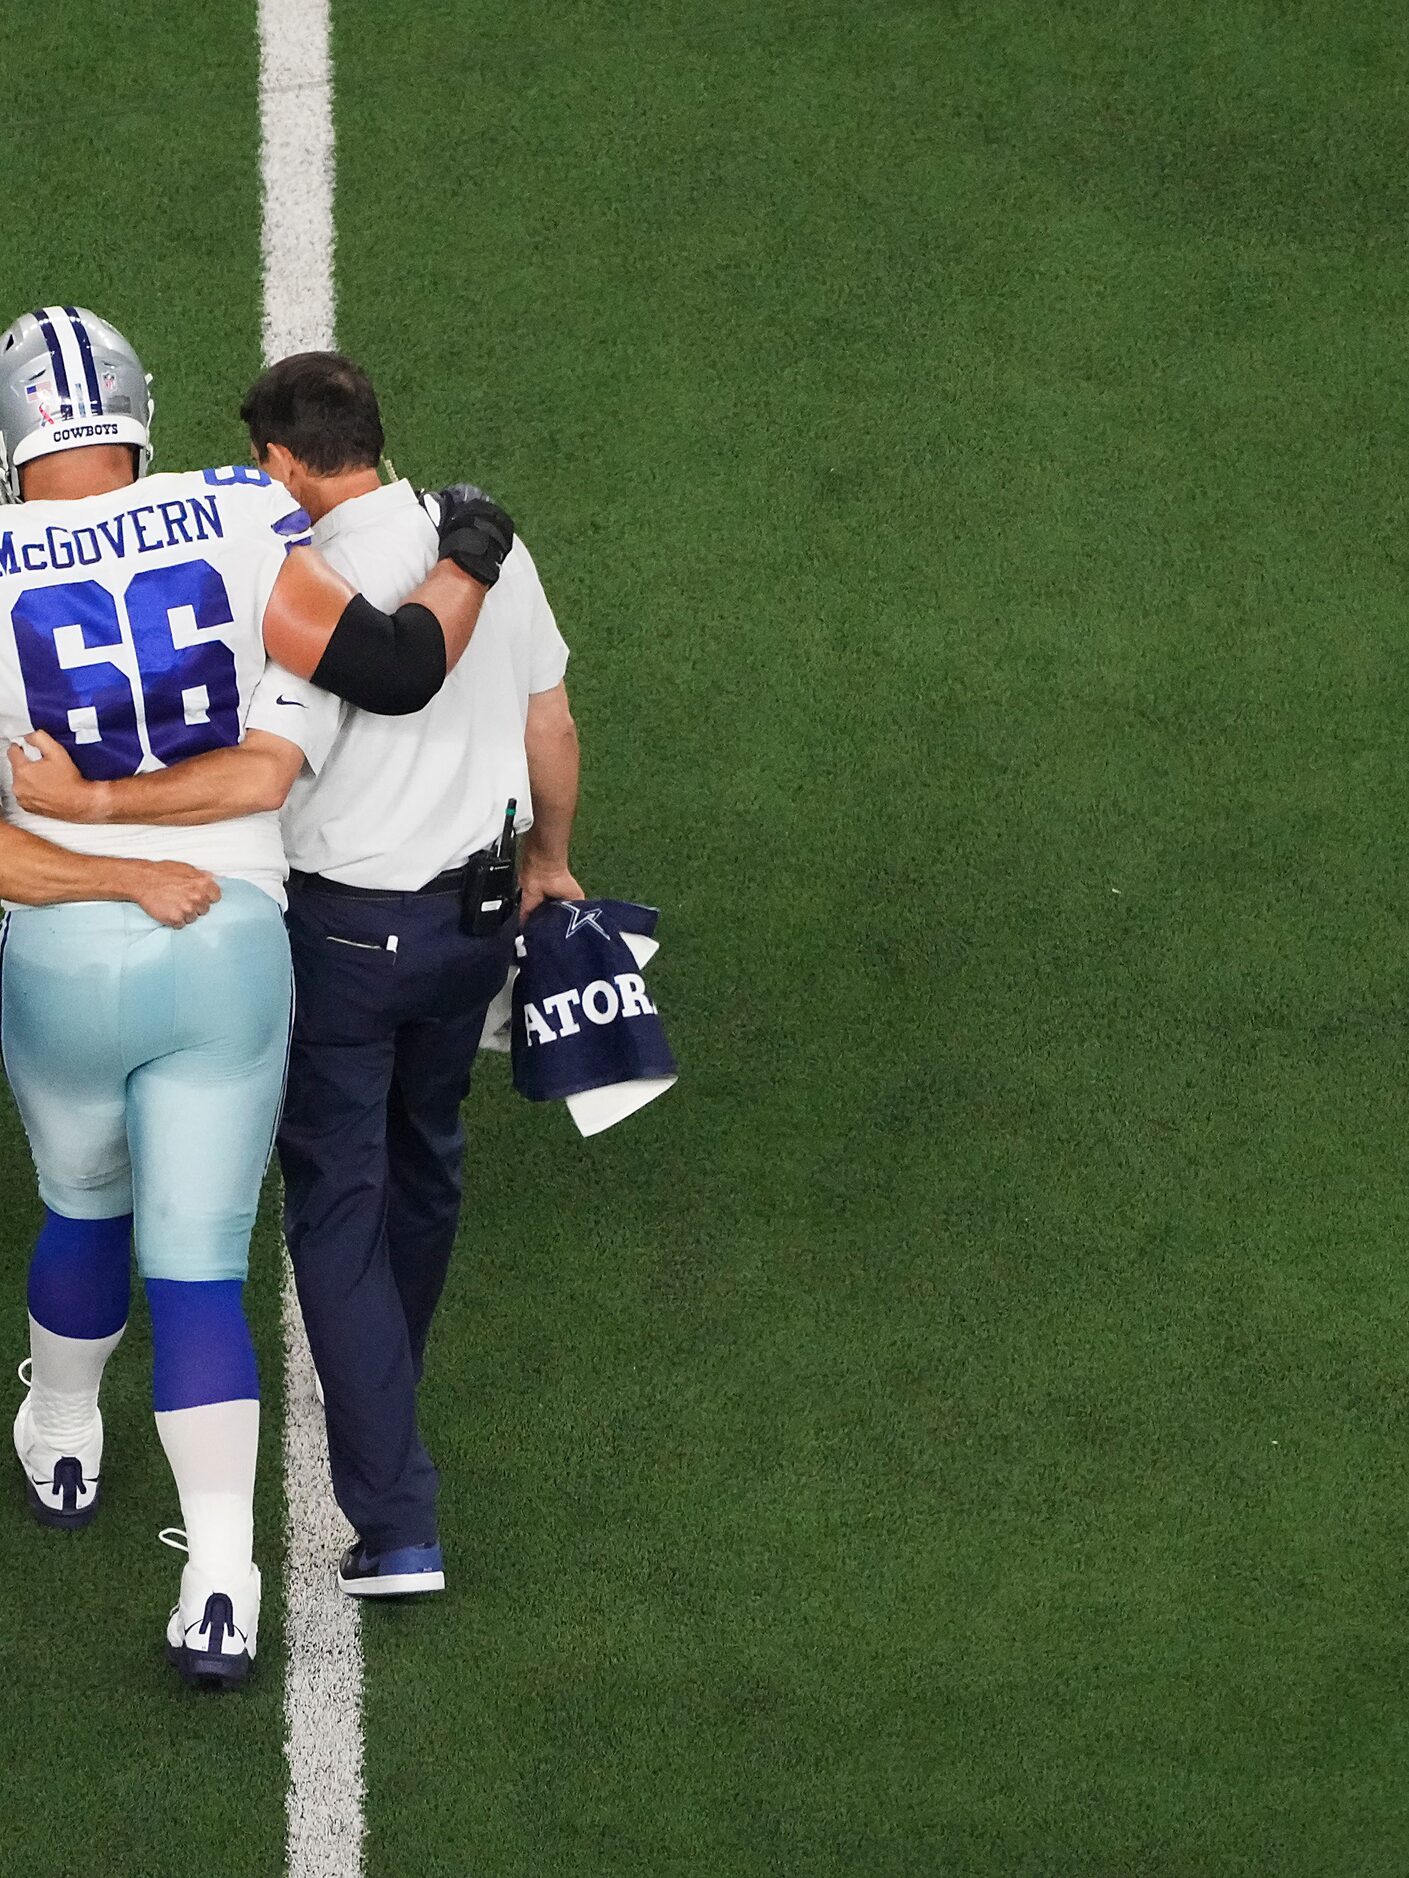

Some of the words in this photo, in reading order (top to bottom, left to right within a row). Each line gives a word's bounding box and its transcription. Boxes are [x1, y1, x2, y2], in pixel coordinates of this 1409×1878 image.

[53, 423, 118, 442] COWBOYS
[10, 558, 240, 782] 66
[523, 973, 658, 1047] ATOR
